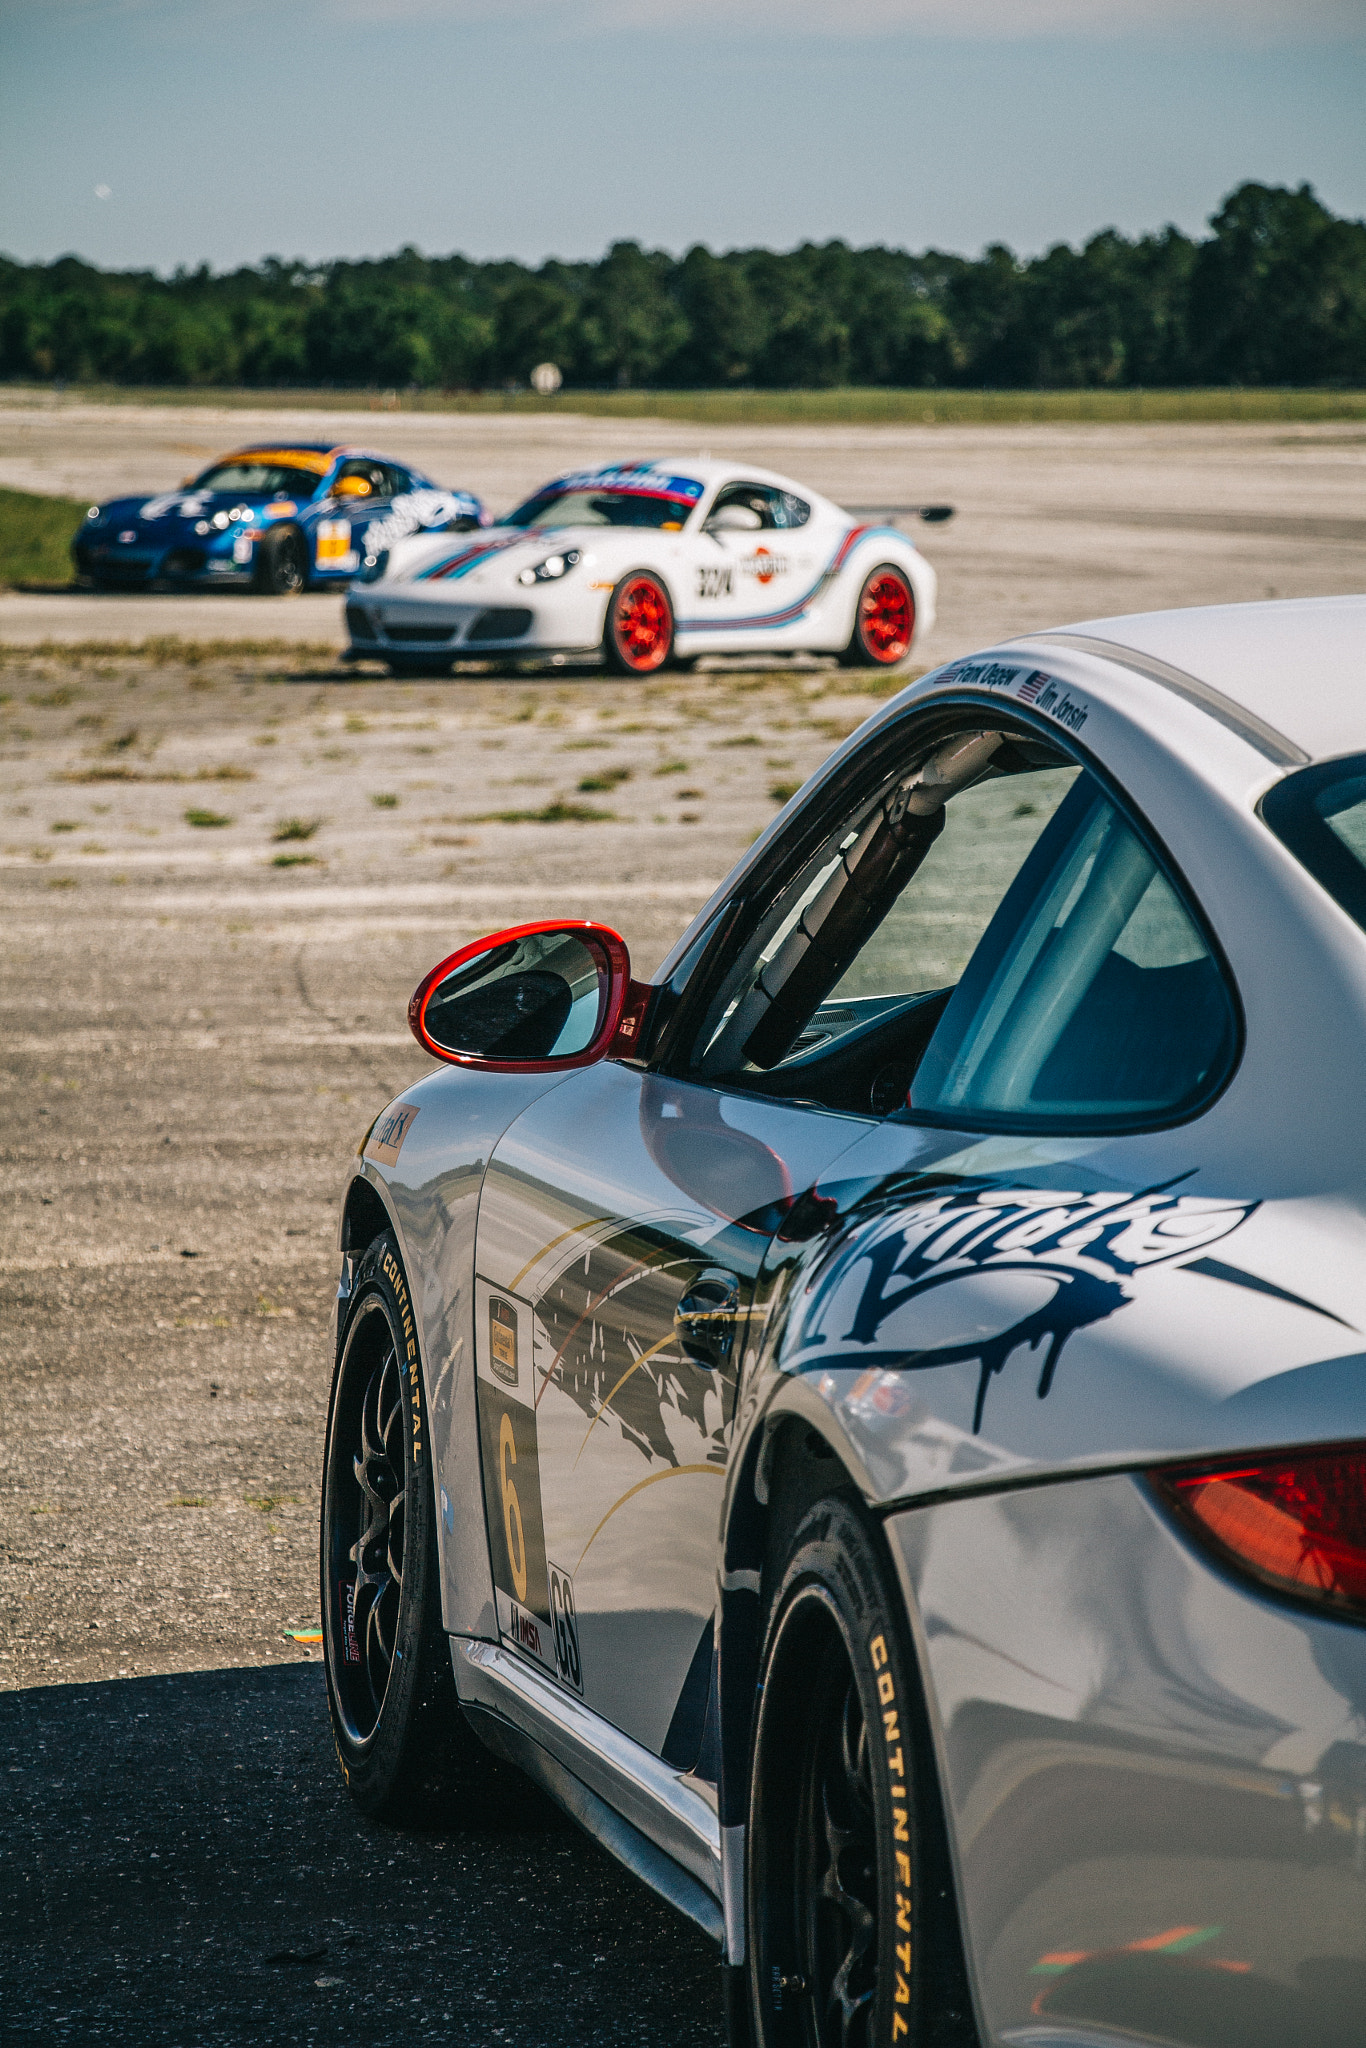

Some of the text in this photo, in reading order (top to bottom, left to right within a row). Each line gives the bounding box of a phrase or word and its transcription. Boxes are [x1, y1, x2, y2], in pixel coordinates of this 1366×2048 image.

[953, 662, 982, 684] Frank
[1035, 682, 1089, 732] Jim Jonsin
[383, 1252, 421, 1463] CONTINENTAL
[498, 1412, 527, 1602] 6
[346, 1584, 359, 1662] FORGELINE
[551, 1570, 580, 1687] GS
[870, 1634, 911, 2043] CONTINENTAL
